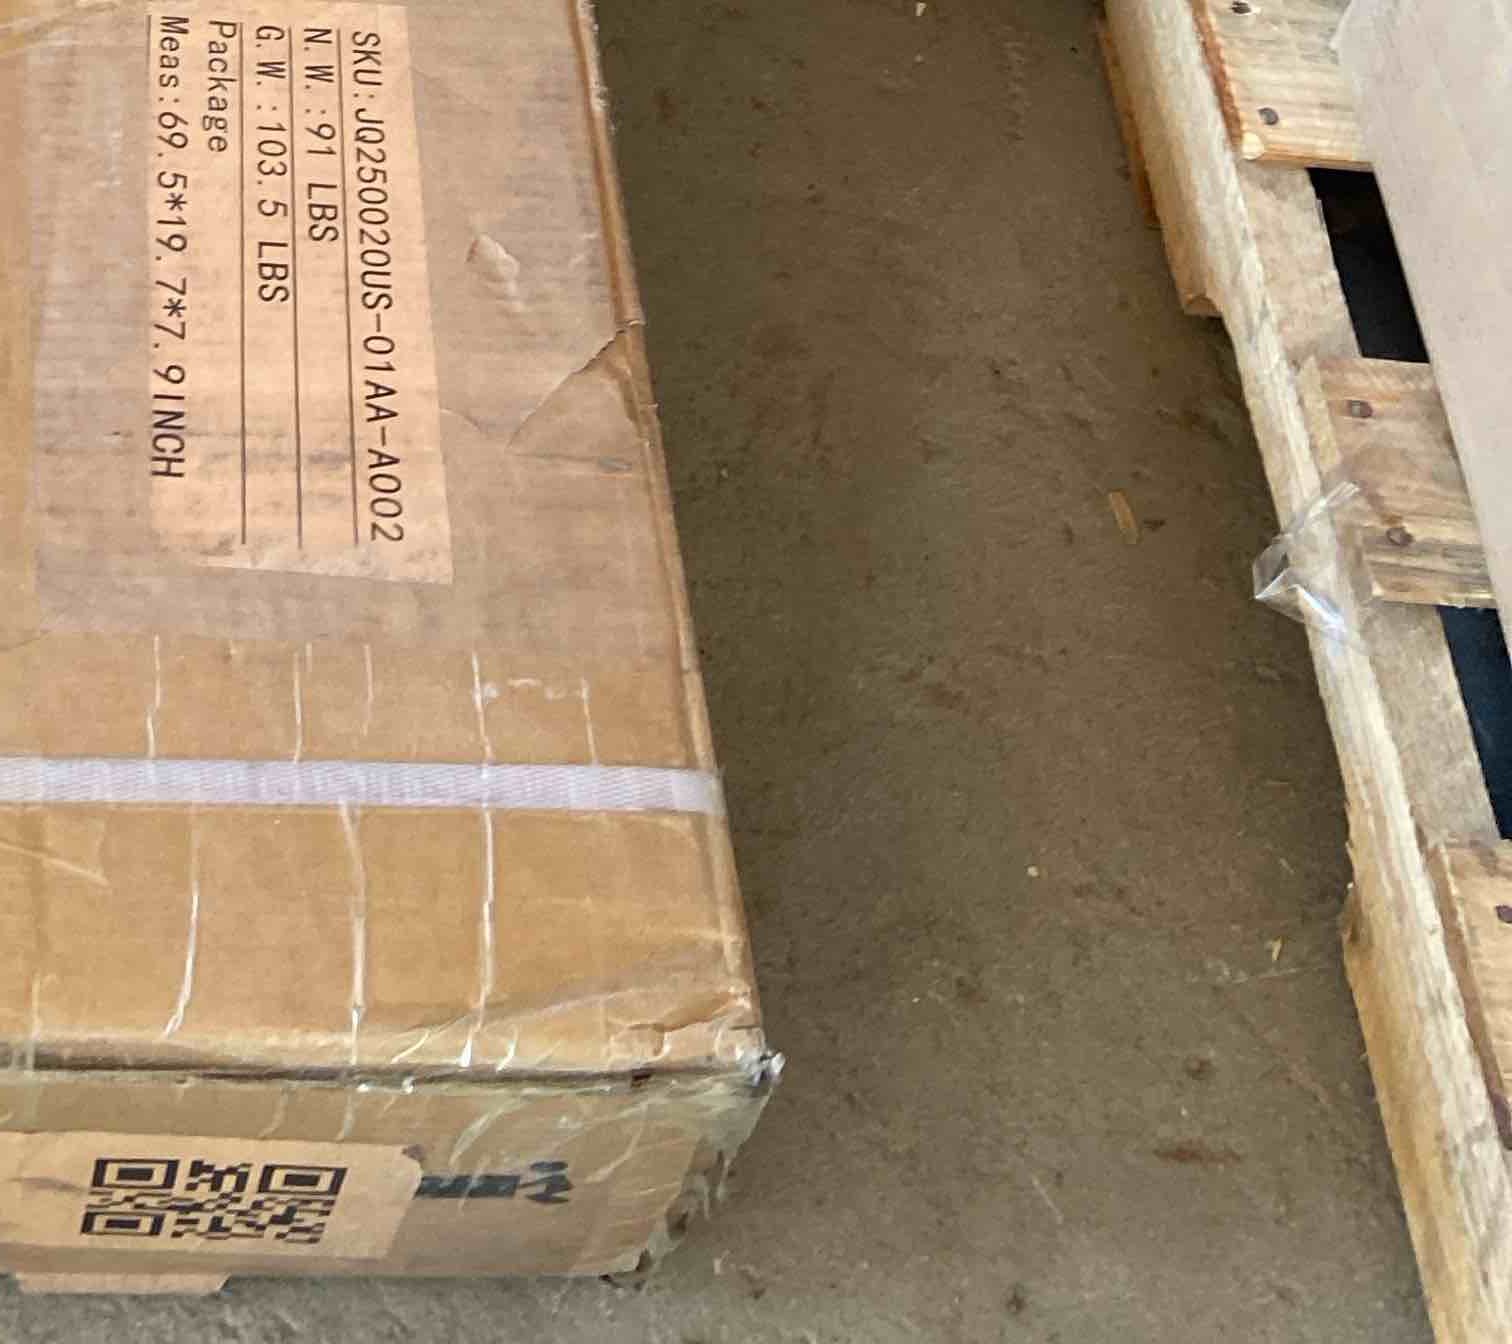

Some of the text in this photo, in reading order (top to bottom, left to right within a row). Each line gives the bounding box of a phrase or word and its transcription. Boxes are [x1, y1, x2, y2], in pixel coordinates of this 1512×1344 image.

[200, 18, 238, 154] Package
[307, 181, 339, 244] LBS
[257, 239, 291, 305] LBS
